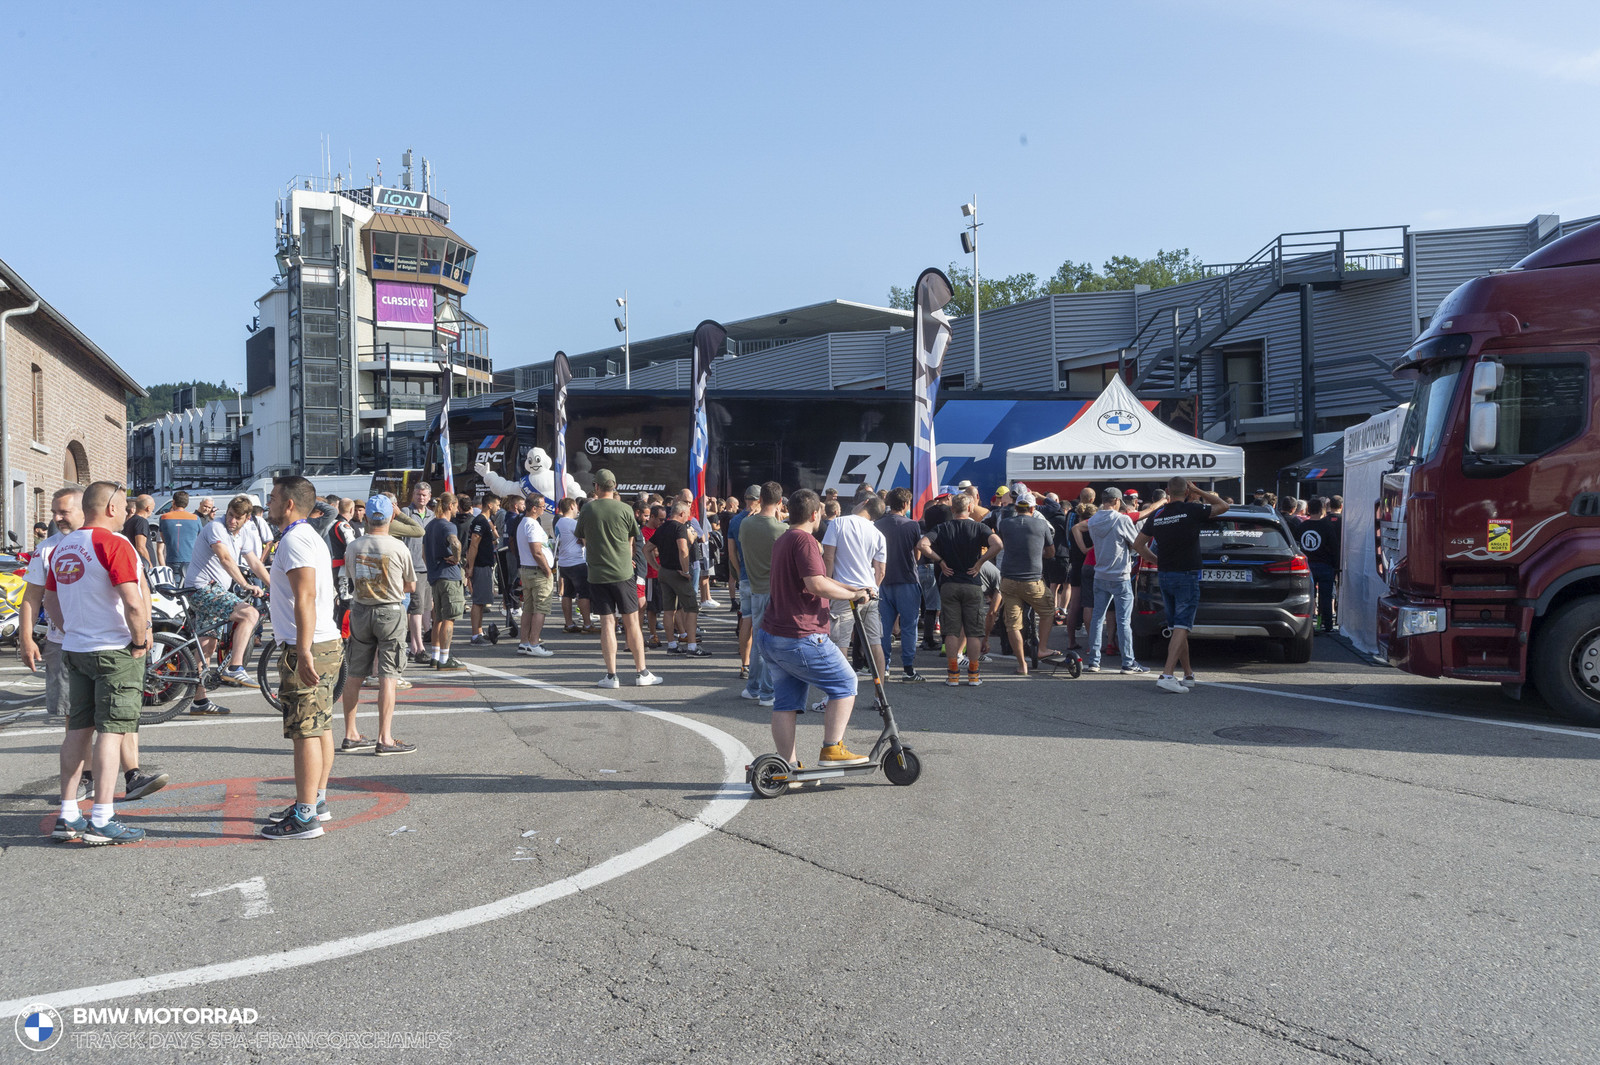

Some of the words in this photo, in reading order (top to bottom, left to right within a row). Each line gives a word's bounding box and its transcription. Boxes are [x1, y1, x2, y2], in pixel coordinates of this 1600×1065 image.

[381, 296, 417, 307] CLASSIC
[418, 298, 428, 308] 21
[1361, 419, 1390, 451] MOTORRAD
[603, 438, 632, 446] Partner
[633, 438, 642, 446] of
[475, 452, 504, 463] BMC
[1033, 455, 1086, 471] BMW
[1093, 453, 1217, 470] MOTORRAD
[1153, 518, 1180, 526] MOTORSPORT
[1163, 513, 1188, 521] MOTORRAD
[79, 545, 92, 563] TEAM
[58, 558, 81, 574] TT
[1202, 570, 1246, 580] FX-673-ZE
